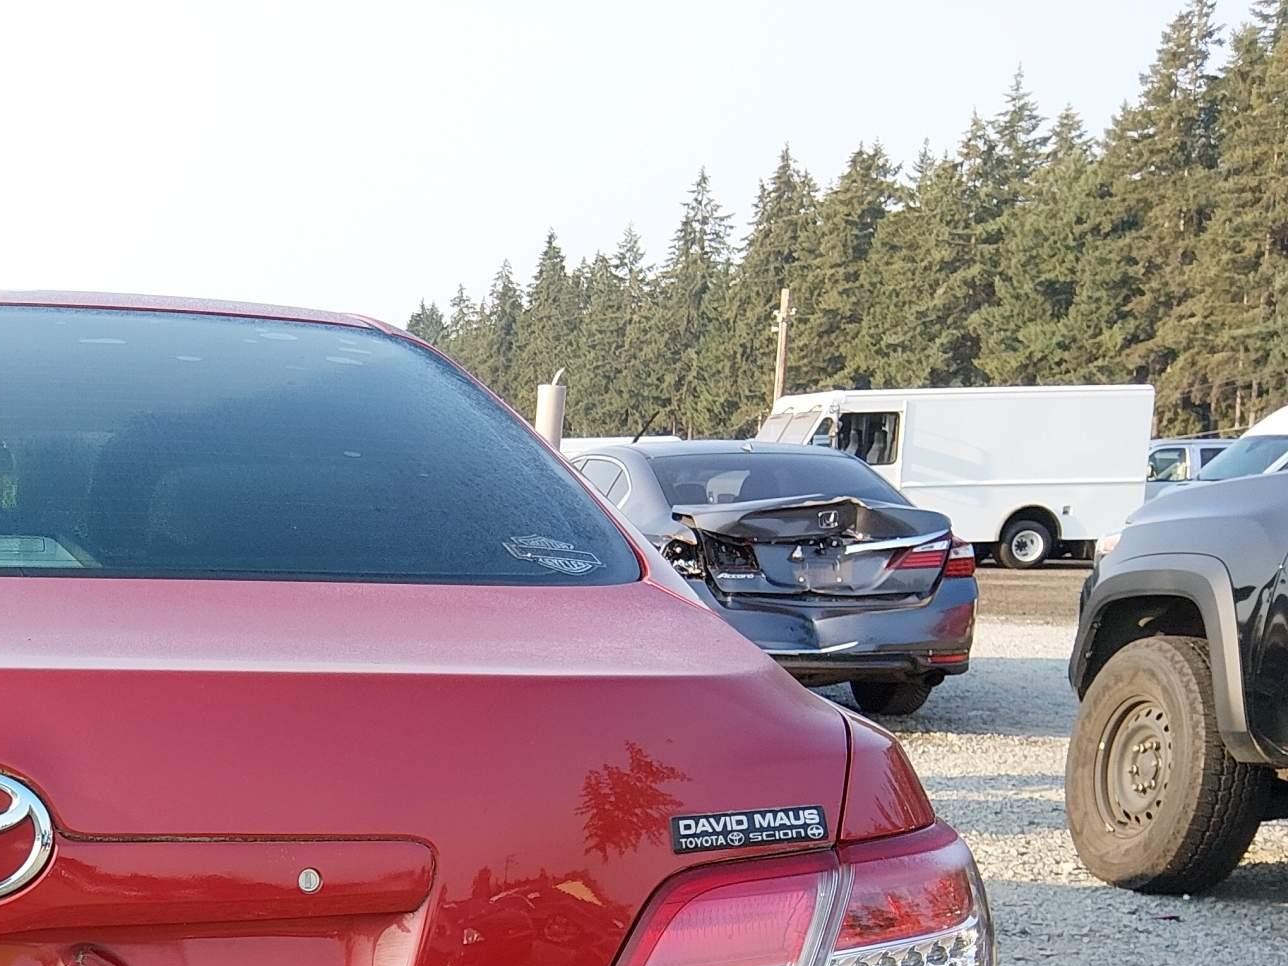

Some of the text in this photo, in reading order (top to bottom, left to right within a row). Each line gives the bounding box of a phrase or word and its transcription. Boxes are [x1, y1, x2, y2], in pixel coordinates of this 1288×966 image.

[679, 809, 820, 835] DAVID MAUS
[679, 835, 726, 849] TOYOTA
